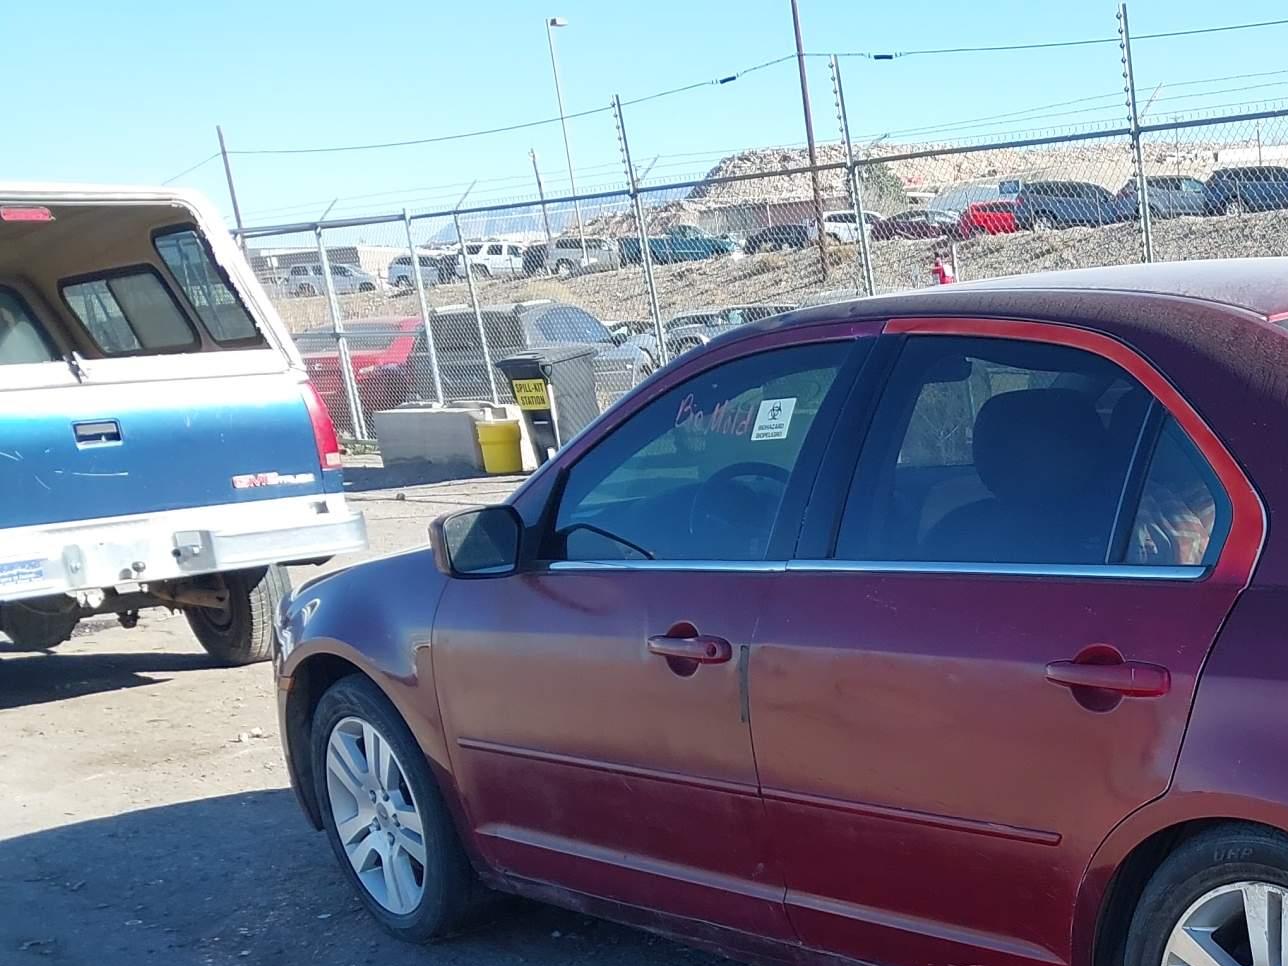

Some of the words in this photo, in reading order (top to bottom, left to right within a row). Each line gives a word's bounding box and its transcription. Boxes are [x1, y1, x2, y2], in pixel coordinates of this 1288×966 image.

[515, 382, 544, 393] SPILL-KIT
[520, 395, 546, 406] STATION
[709, 399, 754, 436] Mold
